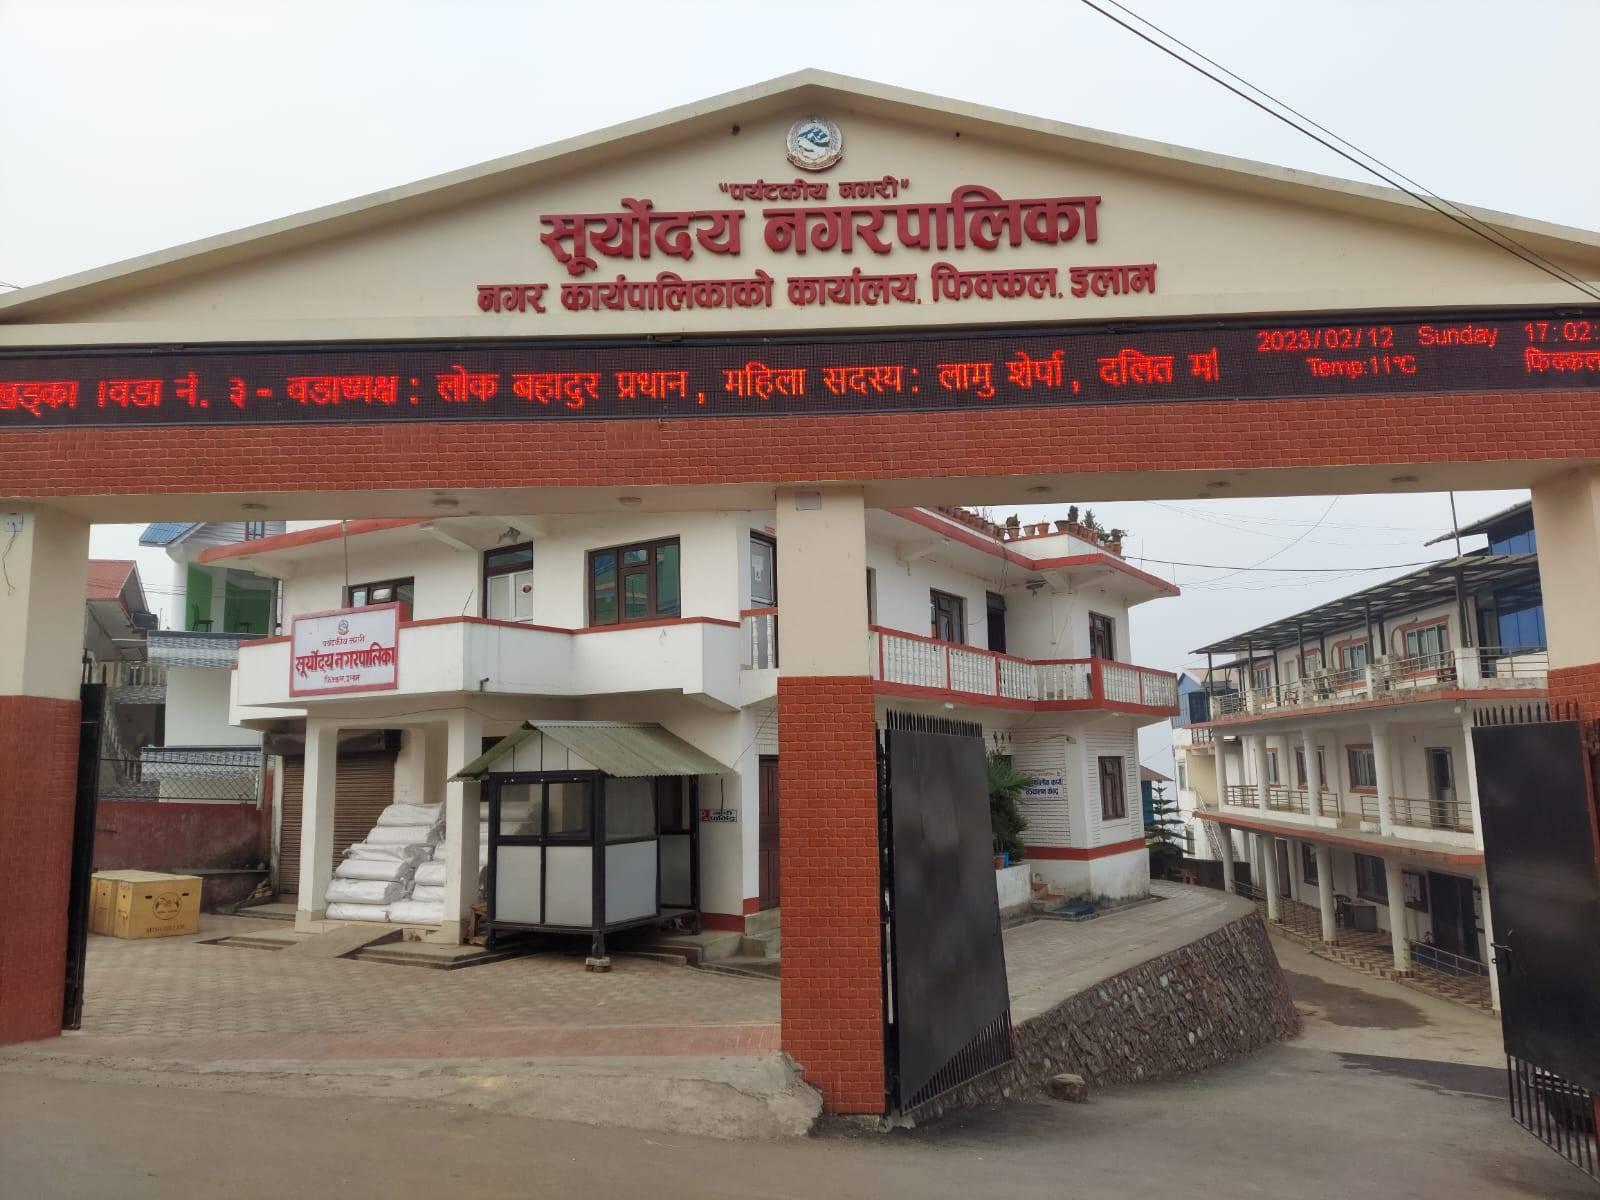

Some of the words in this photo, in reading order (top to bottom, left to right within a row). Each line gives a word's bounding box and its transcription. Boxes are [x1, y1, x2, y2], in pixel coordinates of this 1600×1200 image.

[540, 198, 745, 275] सूर्योदय
[763, 184, 1102, 254] नगरपालिका
[477, 283, 549, 313] नगर
[560, 269, 774, 311] कार्यपालिकाको
[1069, 263, 1157, 298] इलाम
[1257, 326, 1393, 352] 2023/02/12
[1417, 323, 1498, 348] Sunday
[435, 363, 499, 401] लोक
[511, 371, 601, 409] बहादुर
[722, 361, 807, 400] महिला
[1097, 348, 1175, 386] दलित
[296, 650, 334, 679] सूर्योदय
[335, 642, 396, 669] नगरपालिका
